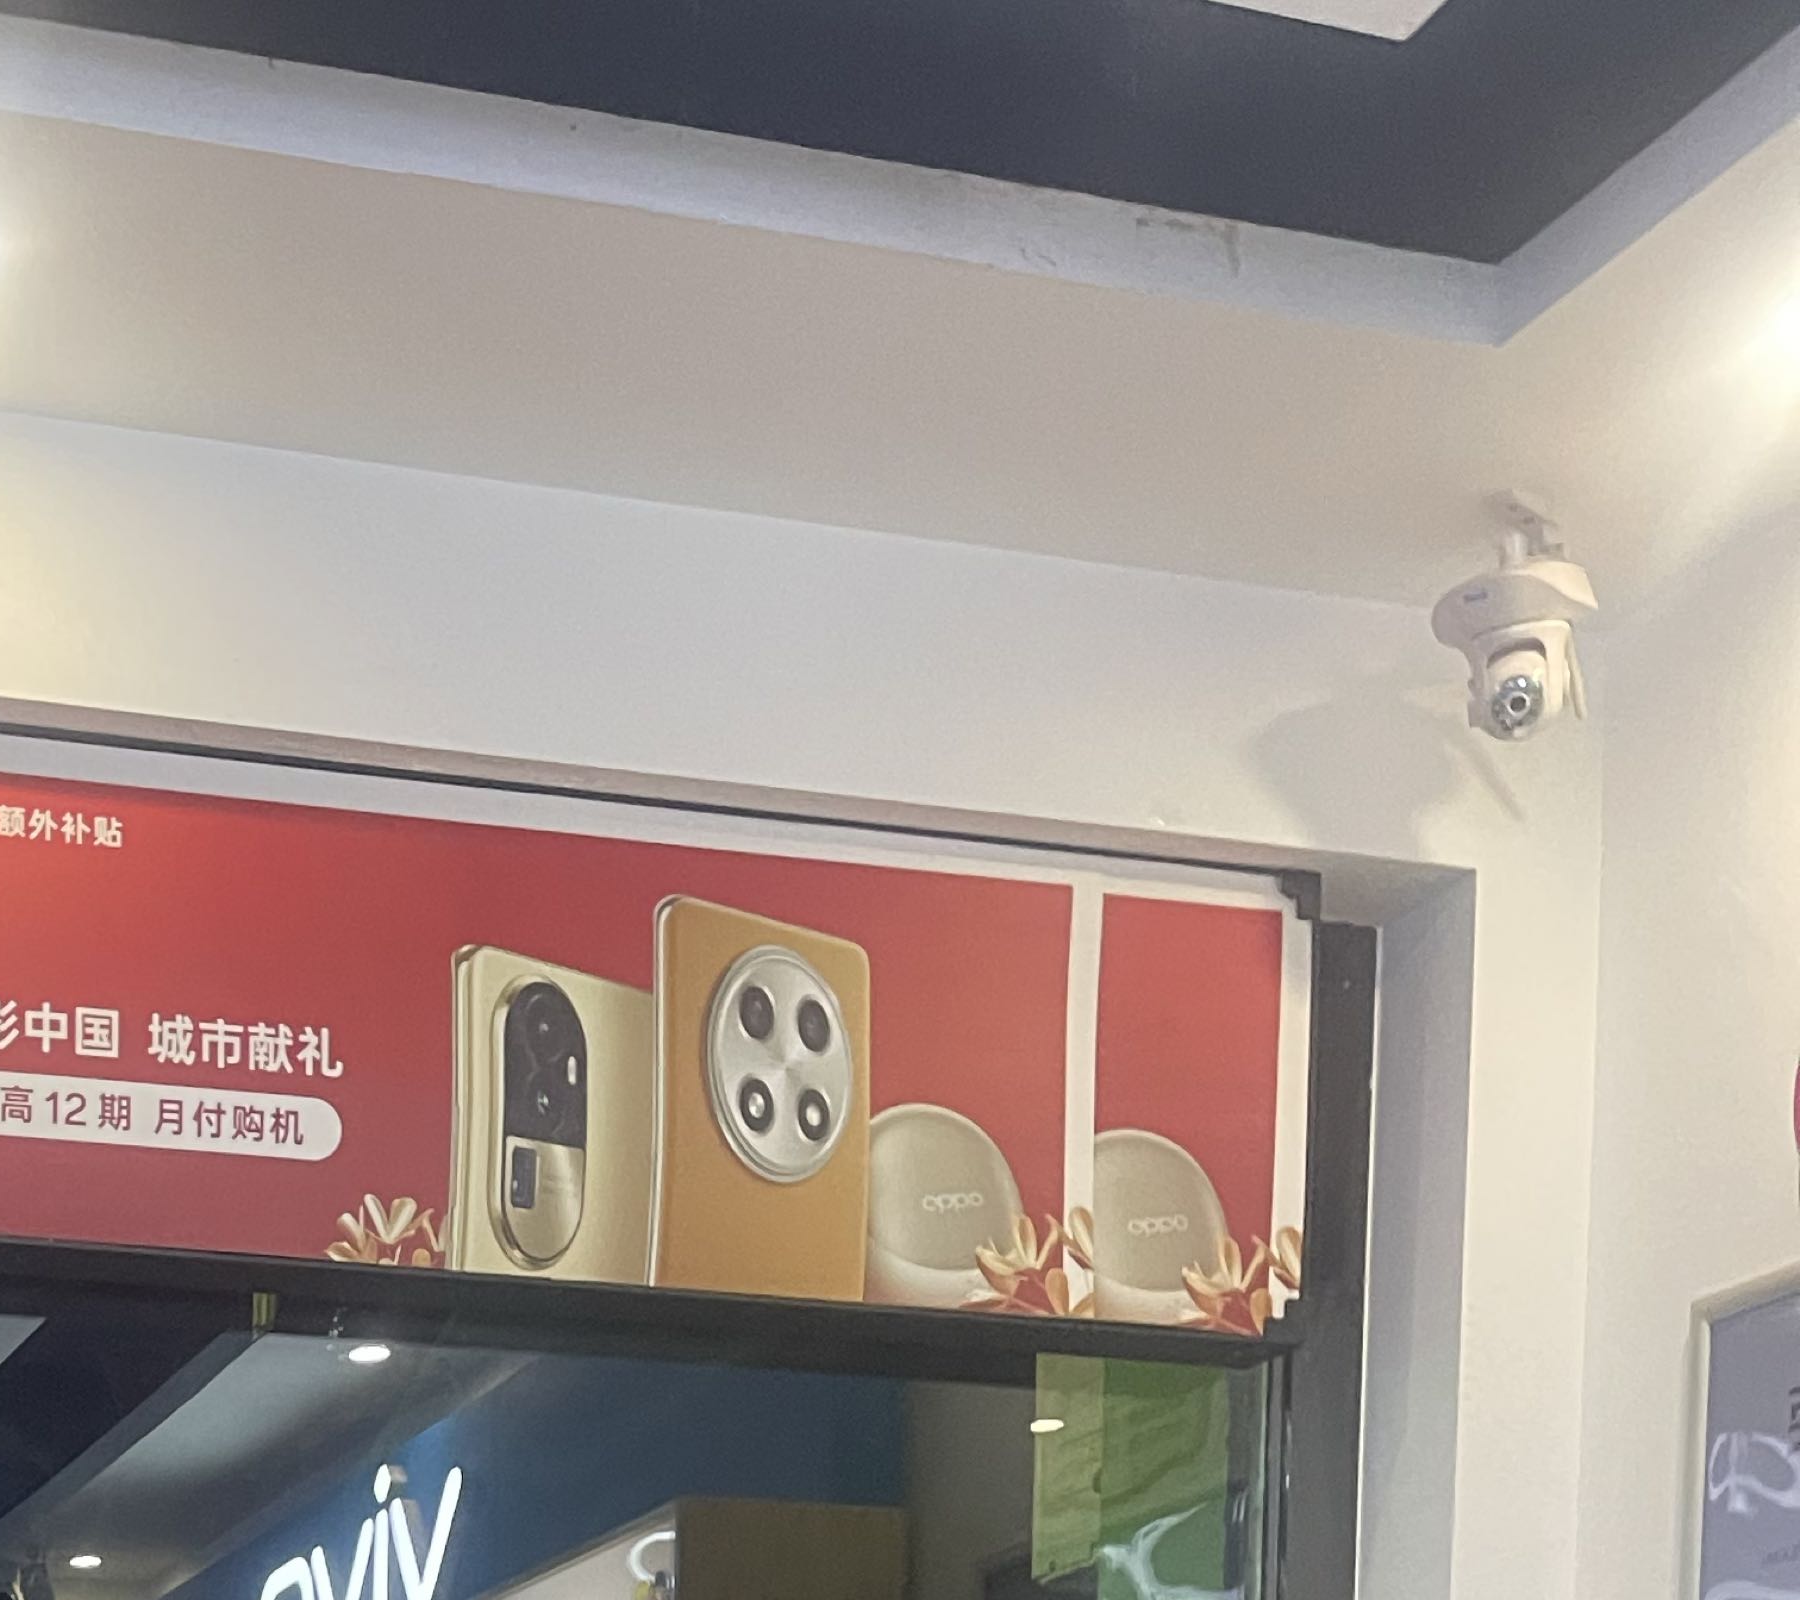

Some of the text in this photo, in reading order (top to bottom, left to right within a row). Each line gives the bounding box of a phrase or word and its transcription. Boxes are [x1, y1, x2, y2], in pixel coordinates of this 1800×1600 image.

[147, 1013, 345, 1079] 城市献礼
[153, 1097, 305, 1147] 月付购机
